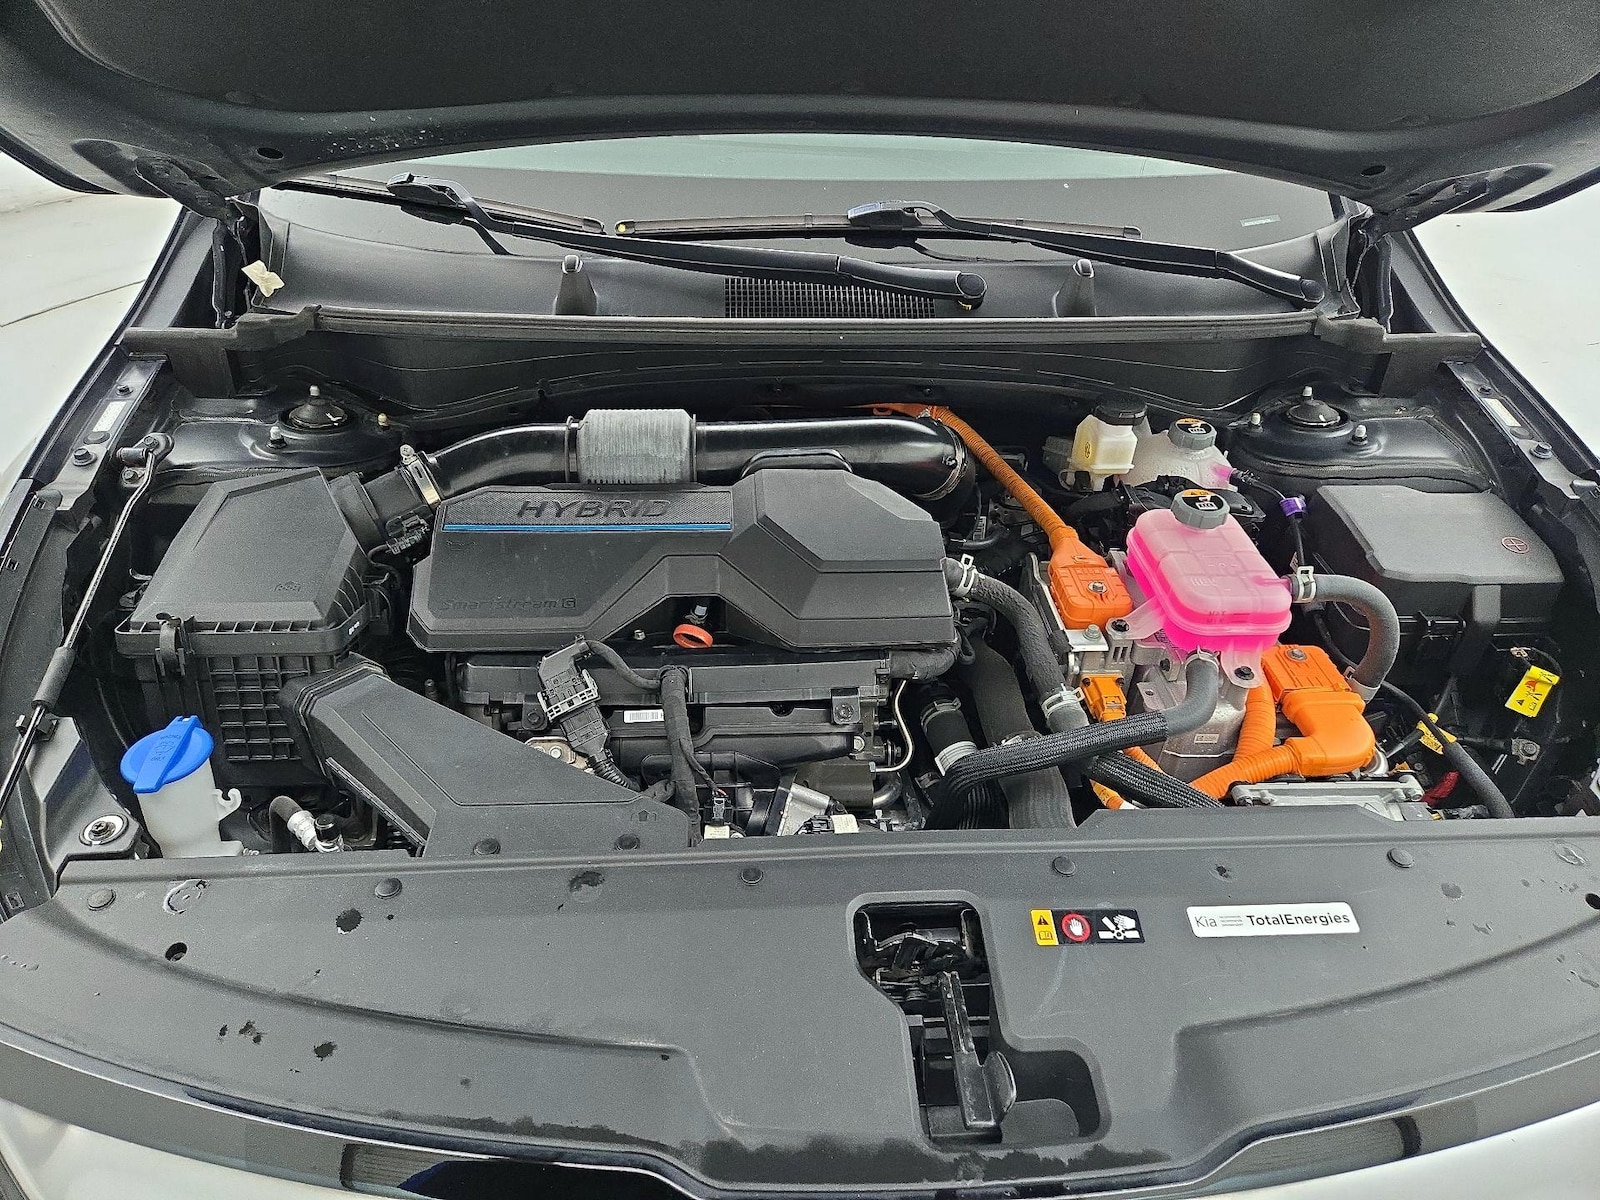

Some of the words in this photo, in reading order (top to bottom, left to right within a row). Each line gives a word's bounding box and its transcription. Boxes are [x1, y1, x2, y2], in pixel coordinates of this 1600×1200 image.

[516, 499, 671, 518] HYBRID
[1195, 916, 1218, 928] Kia
[1246, 912, 1350, 927] TotalEnergies
